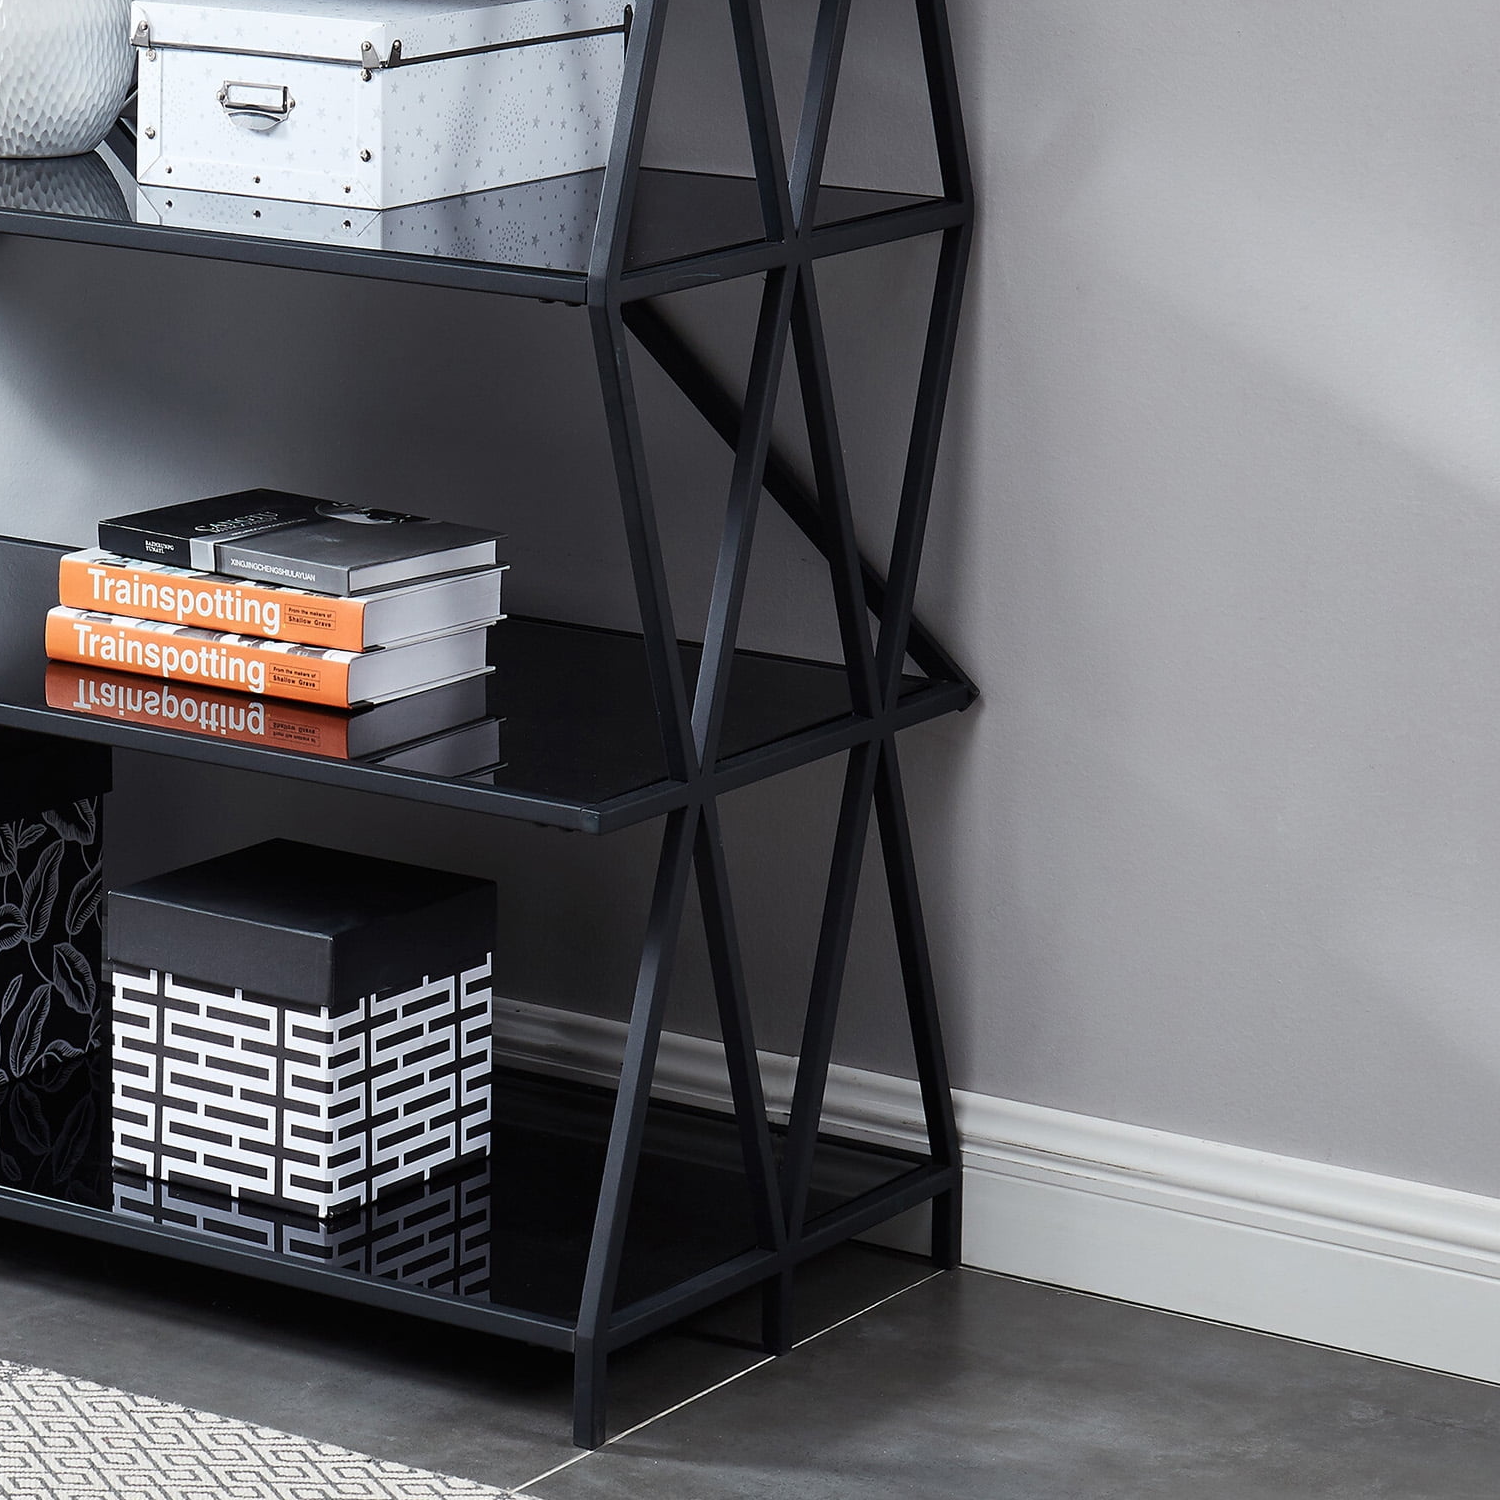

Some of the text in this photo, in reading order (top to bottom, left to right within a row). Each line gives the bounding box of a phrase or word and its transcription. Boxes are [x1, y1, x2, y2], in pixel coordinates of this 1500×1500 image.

[87, 567, 280, 634] Trainspotting
[288, 616, 331, 628] Shallow Grave
[73, 623, 265, 693] Trainspotting
[273, 675, 315, 687] Shallow Grave
